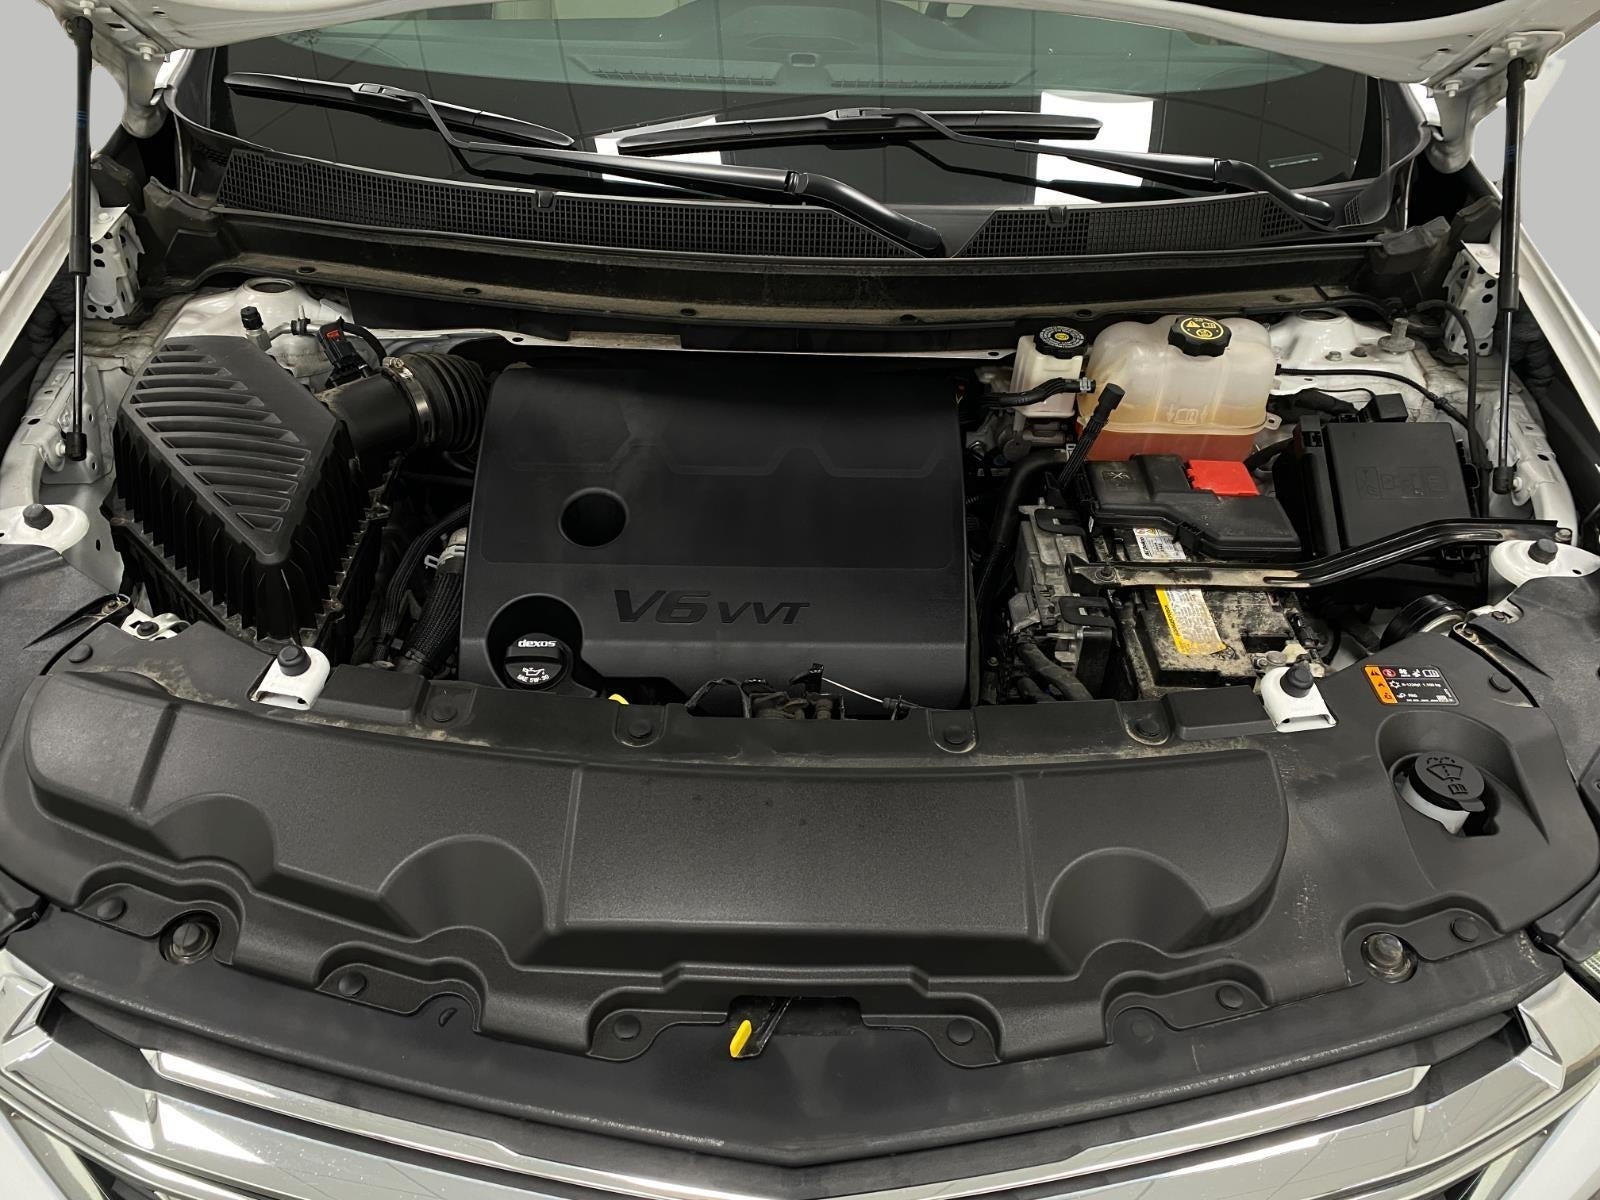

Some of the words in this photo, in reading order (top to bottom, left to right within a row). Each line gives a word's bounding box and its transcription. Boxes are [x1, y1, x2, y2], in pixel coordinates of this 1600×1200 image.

[614, 589, 712, 625] V6
[717, 601, 811, 625] VVT
[517, 639, 558, 648] dexos
